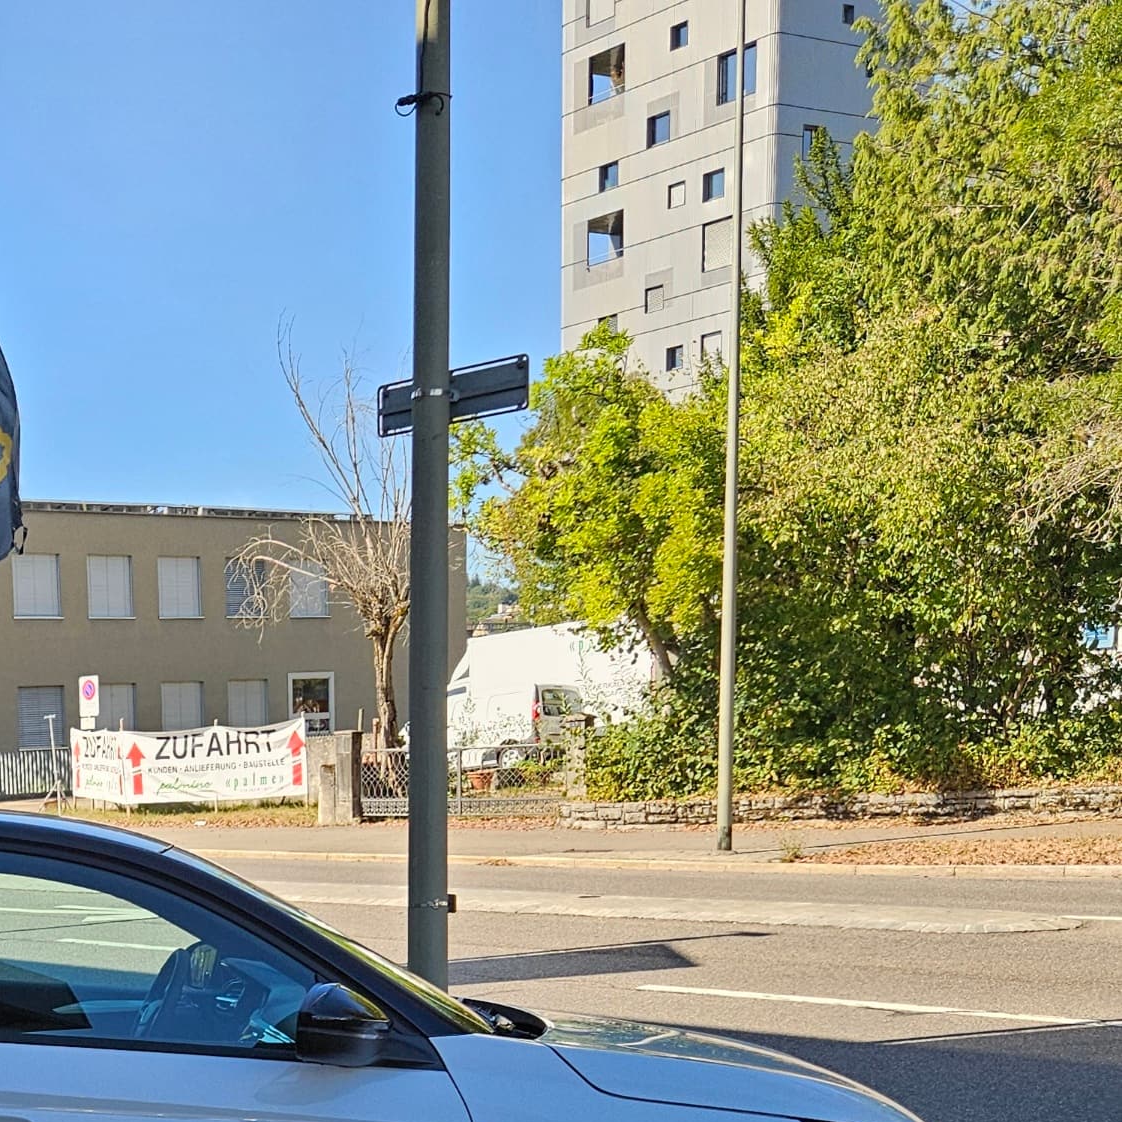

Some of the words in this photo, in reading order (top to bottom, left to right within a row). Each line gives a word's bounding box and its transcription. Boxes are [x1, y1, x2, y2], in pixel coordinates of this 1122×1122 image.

[155, 729, 277, 760] ZUFAHRT
[147, 765, 178, 774] KUNDEN
[184, 761, 237, 773] ANLIEFERUNG
[243, 757, 285, 769] BAUSTELLE
